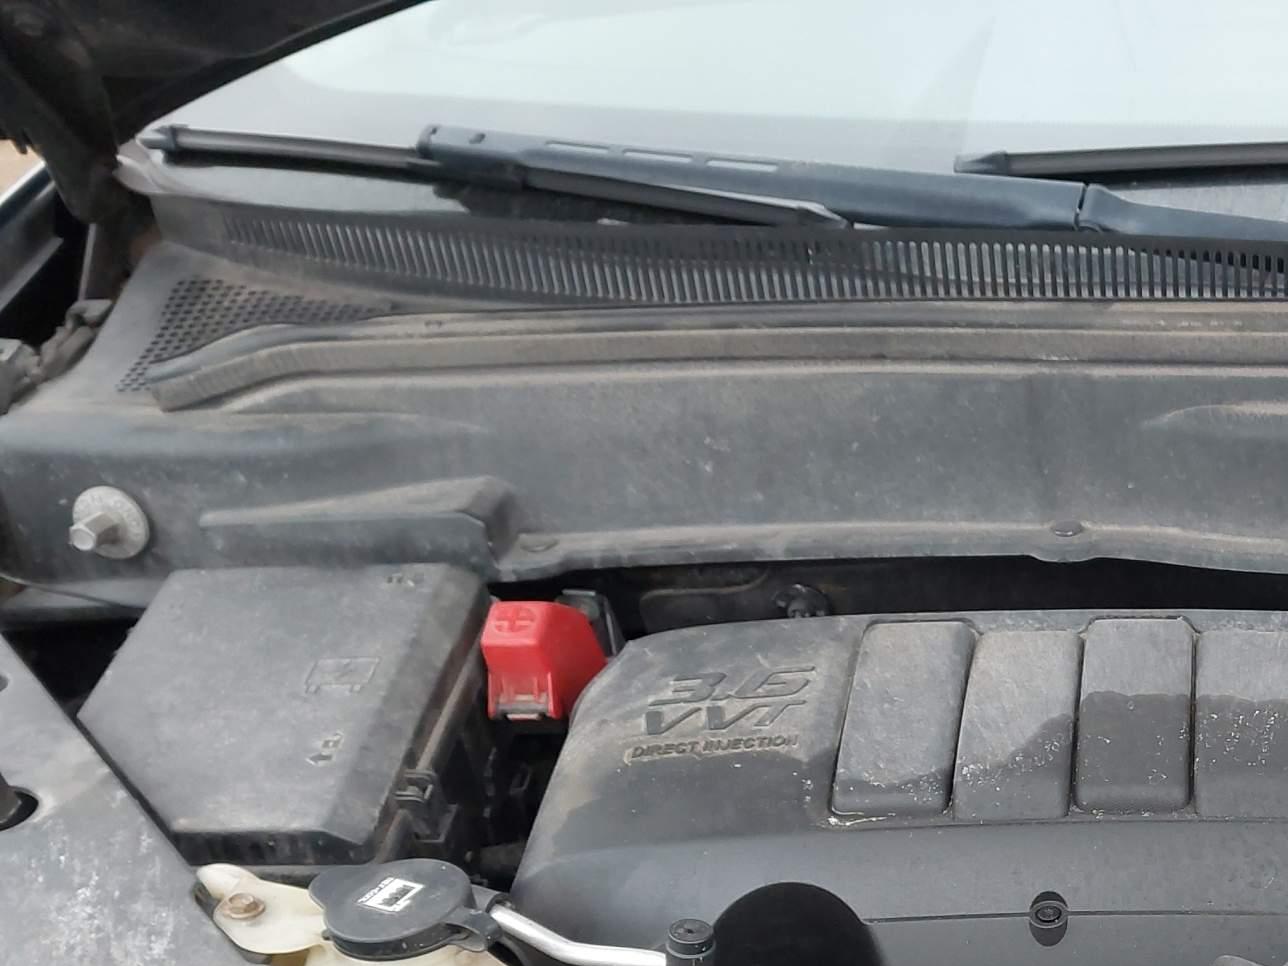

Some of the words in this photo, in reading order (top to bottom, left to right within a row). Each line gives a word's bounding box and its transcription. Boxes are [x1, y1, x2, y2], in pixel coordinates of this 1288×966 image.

[648, 666, 816, 707] 3.6
[644, 699, 808, 736] VVT
[631, 740, 699, 760] DIRECT
[702, 734, 800, 753] INJECTION
